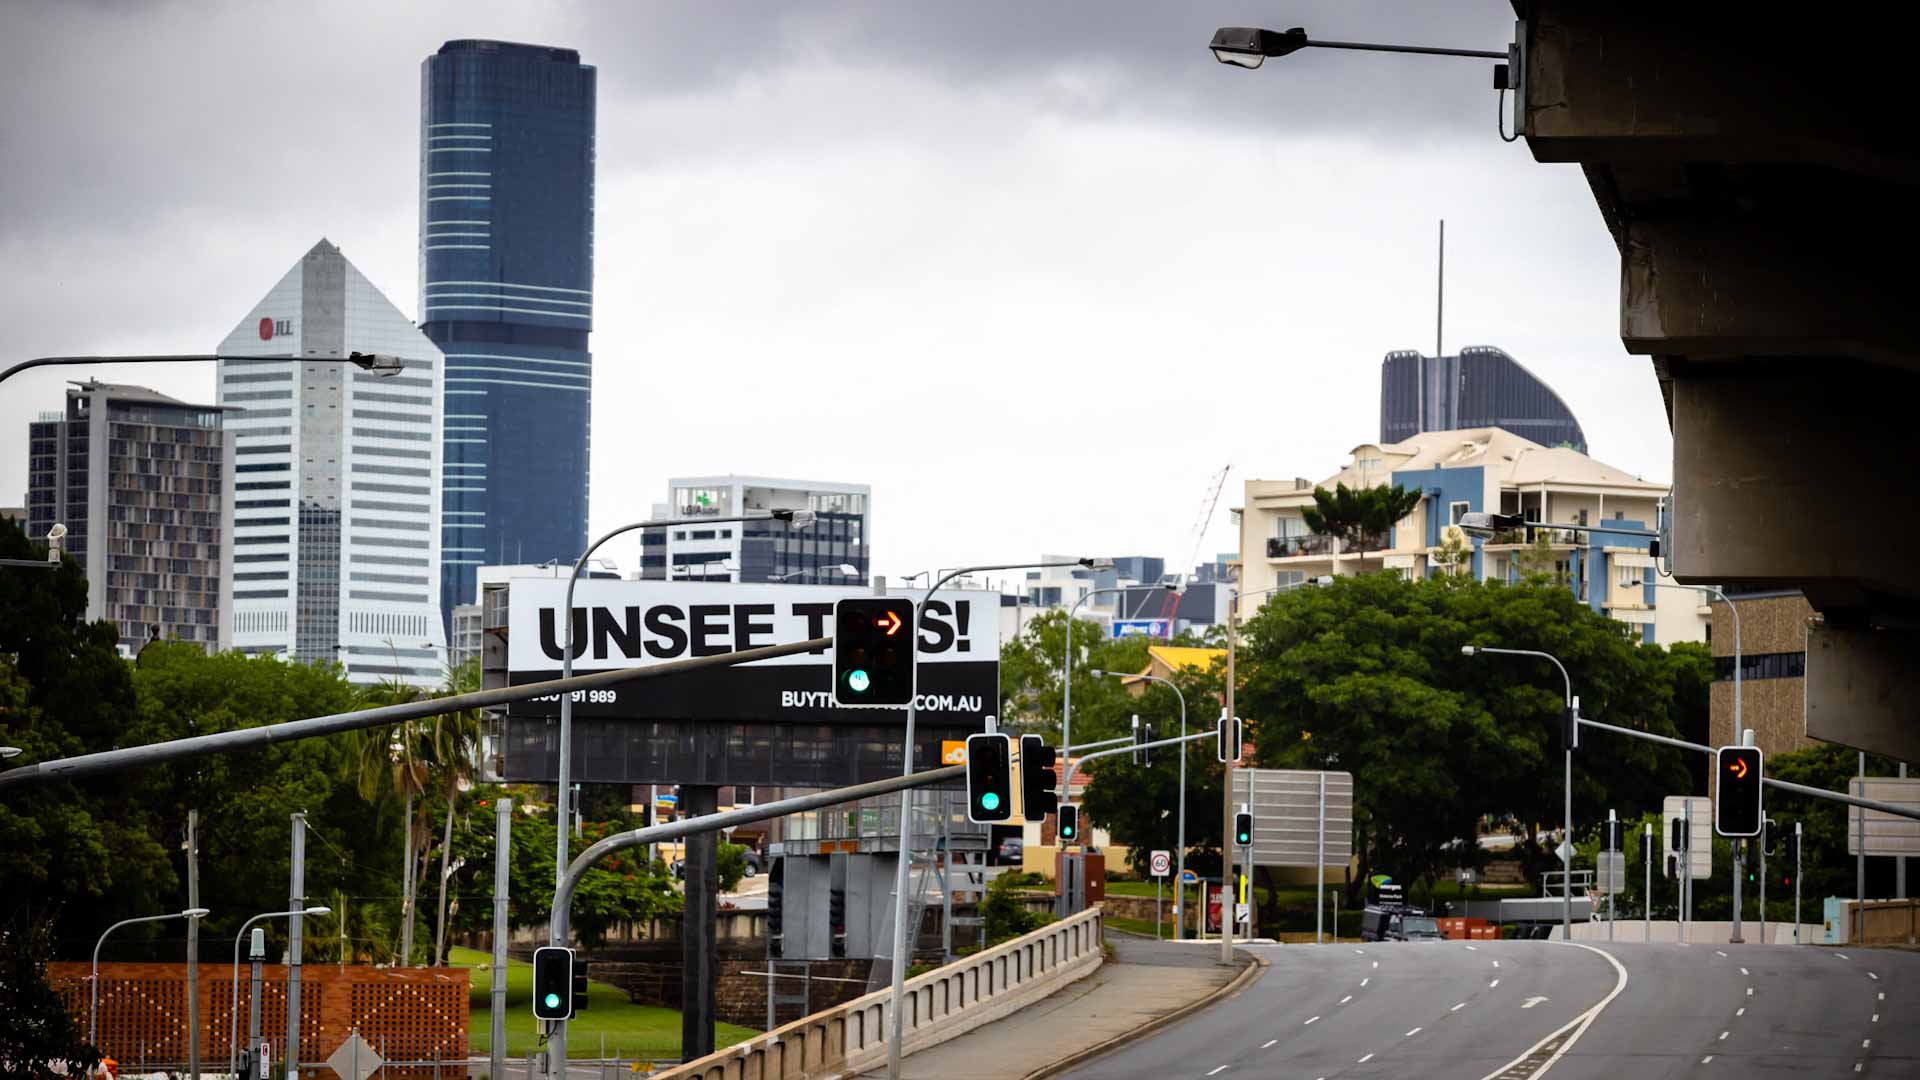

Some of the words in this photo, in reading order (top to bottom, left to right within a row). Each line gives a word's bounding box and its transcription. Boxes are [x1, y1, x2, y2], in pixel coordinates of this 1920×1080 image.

[539, 604, 777, 661] UNSEE
[791, 600, 971, 654] TS!
[589, 689, 617, 703] 989
[1155, 858, 1167, 868] 60
